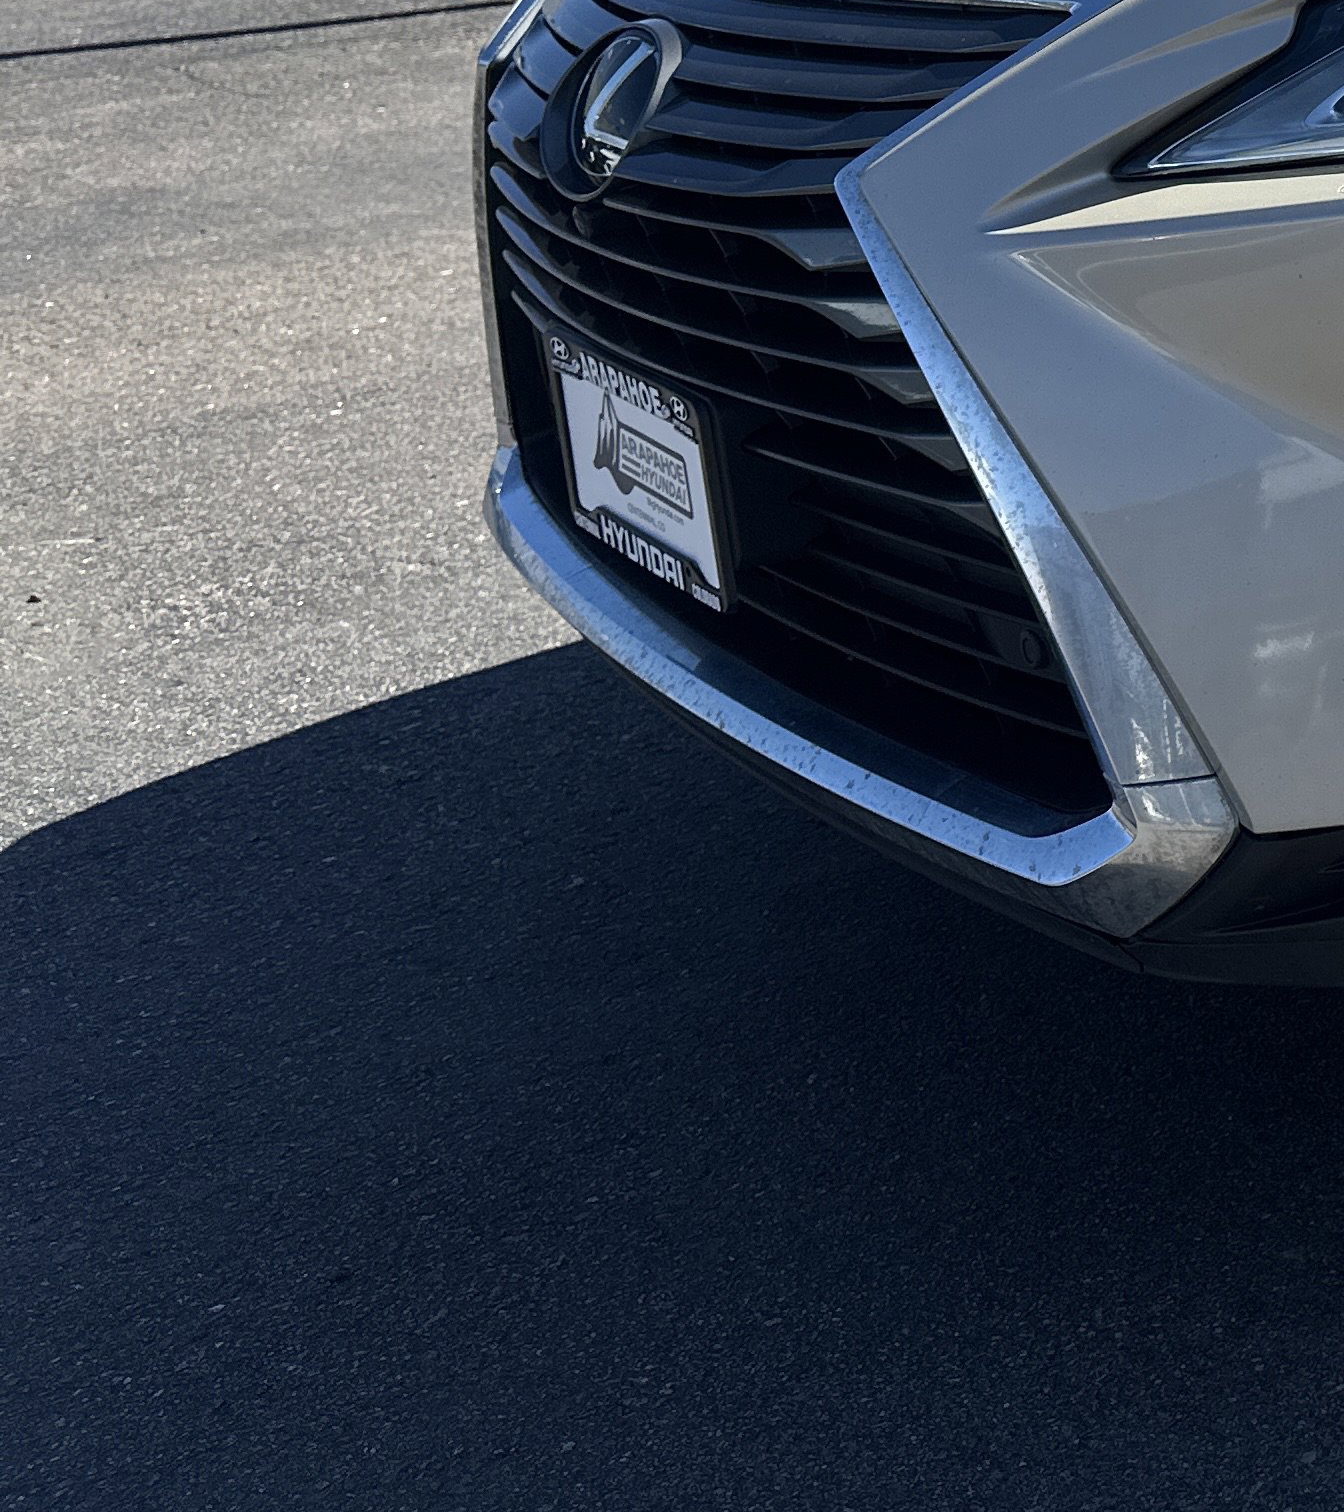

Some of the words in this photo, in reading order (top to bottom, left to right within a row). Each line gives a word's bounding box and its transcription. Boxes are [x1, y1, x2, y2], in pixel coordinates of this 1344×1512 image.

[580, 351, 662, 416] ARAPAHOE
[621, 432, 685, 486] ARAPAHOE
[641, 464, 687, 506] HYUNDAI
[600, 514, 685, 590] HYUNDAI
